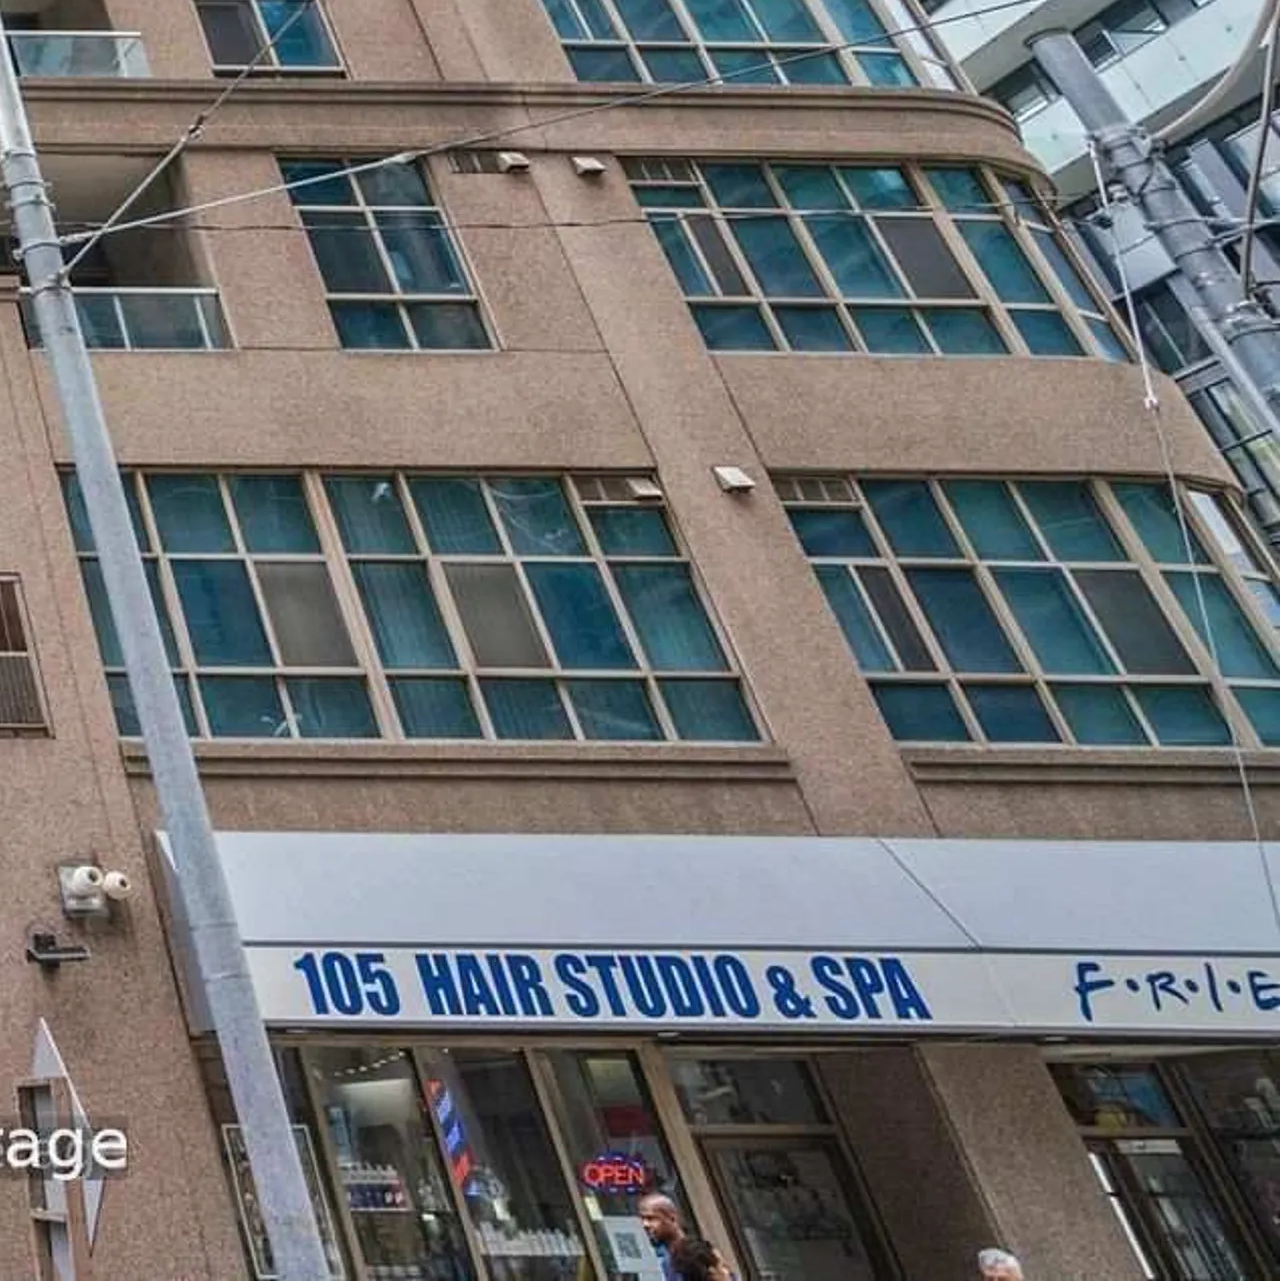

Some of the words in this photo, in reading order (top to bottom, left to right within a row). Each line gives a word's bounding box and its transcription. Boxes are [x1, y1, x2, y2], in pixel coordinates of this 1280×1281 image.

[294, 952, 400, 1016] 105
[415, 953, 553, 1016] HAIR
[555, 953, 760, 1018] STUDIO
[767, 965, 817, 1018] &
[811, 955, 933, 1019] SPA
[583, 1162, 644, 1186] OPEN
